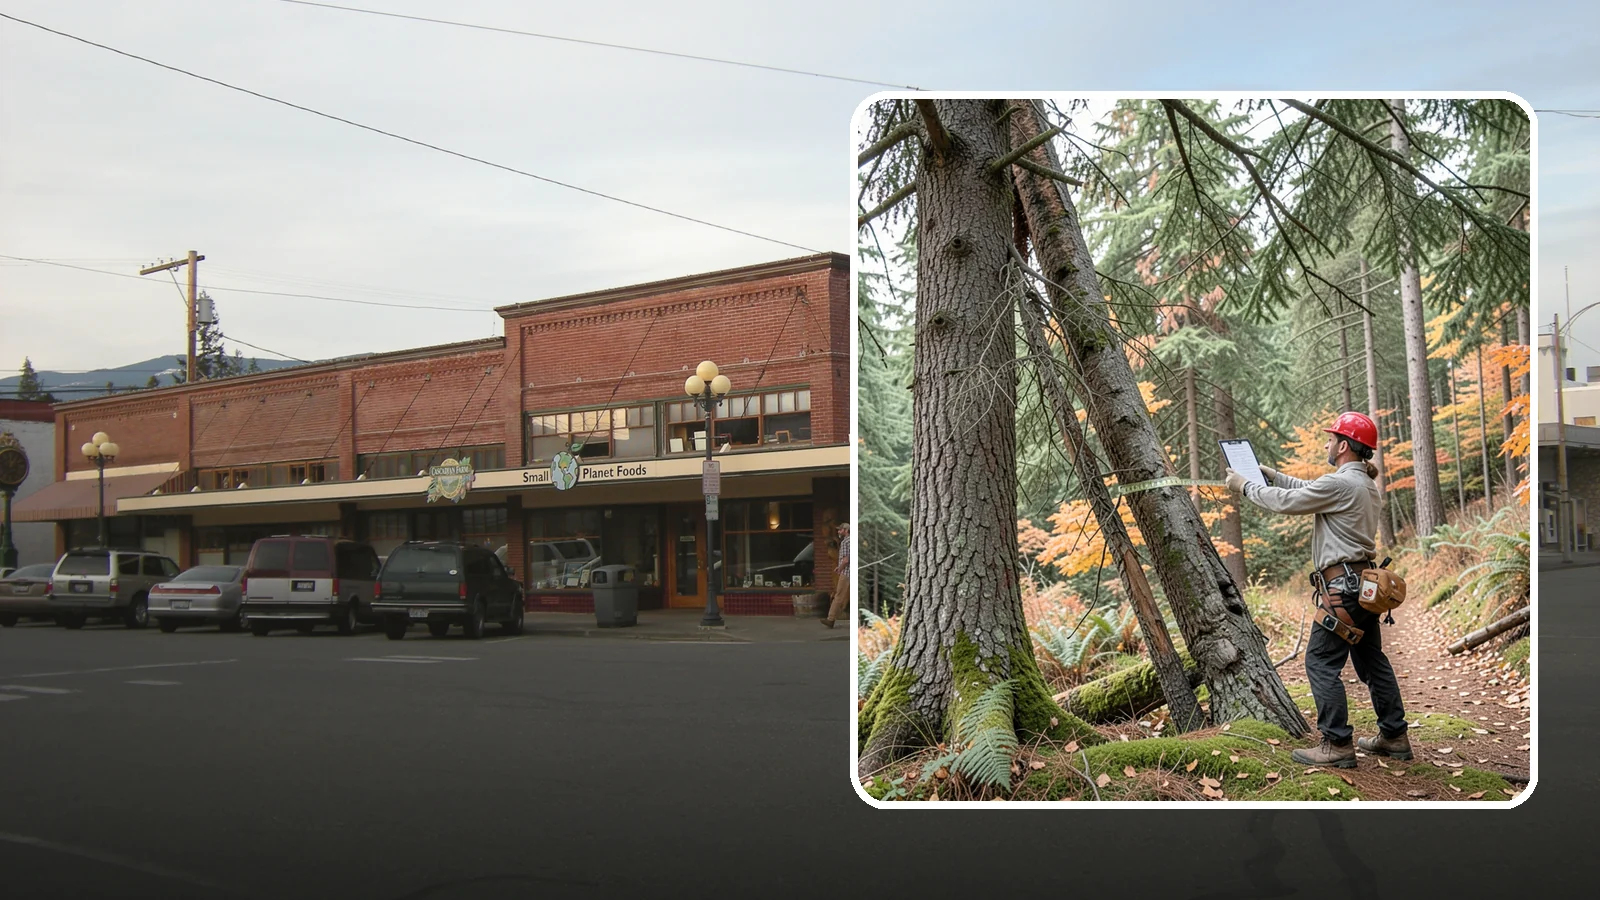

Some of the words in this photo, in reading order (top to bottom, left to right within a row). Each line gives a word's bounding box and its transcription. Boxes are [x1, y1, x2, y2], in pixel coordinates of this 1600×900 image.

[523, 471, 549, 483] Small
[583, 467, 614, 479] Planet
[617, 464, 647, 477] Foods
